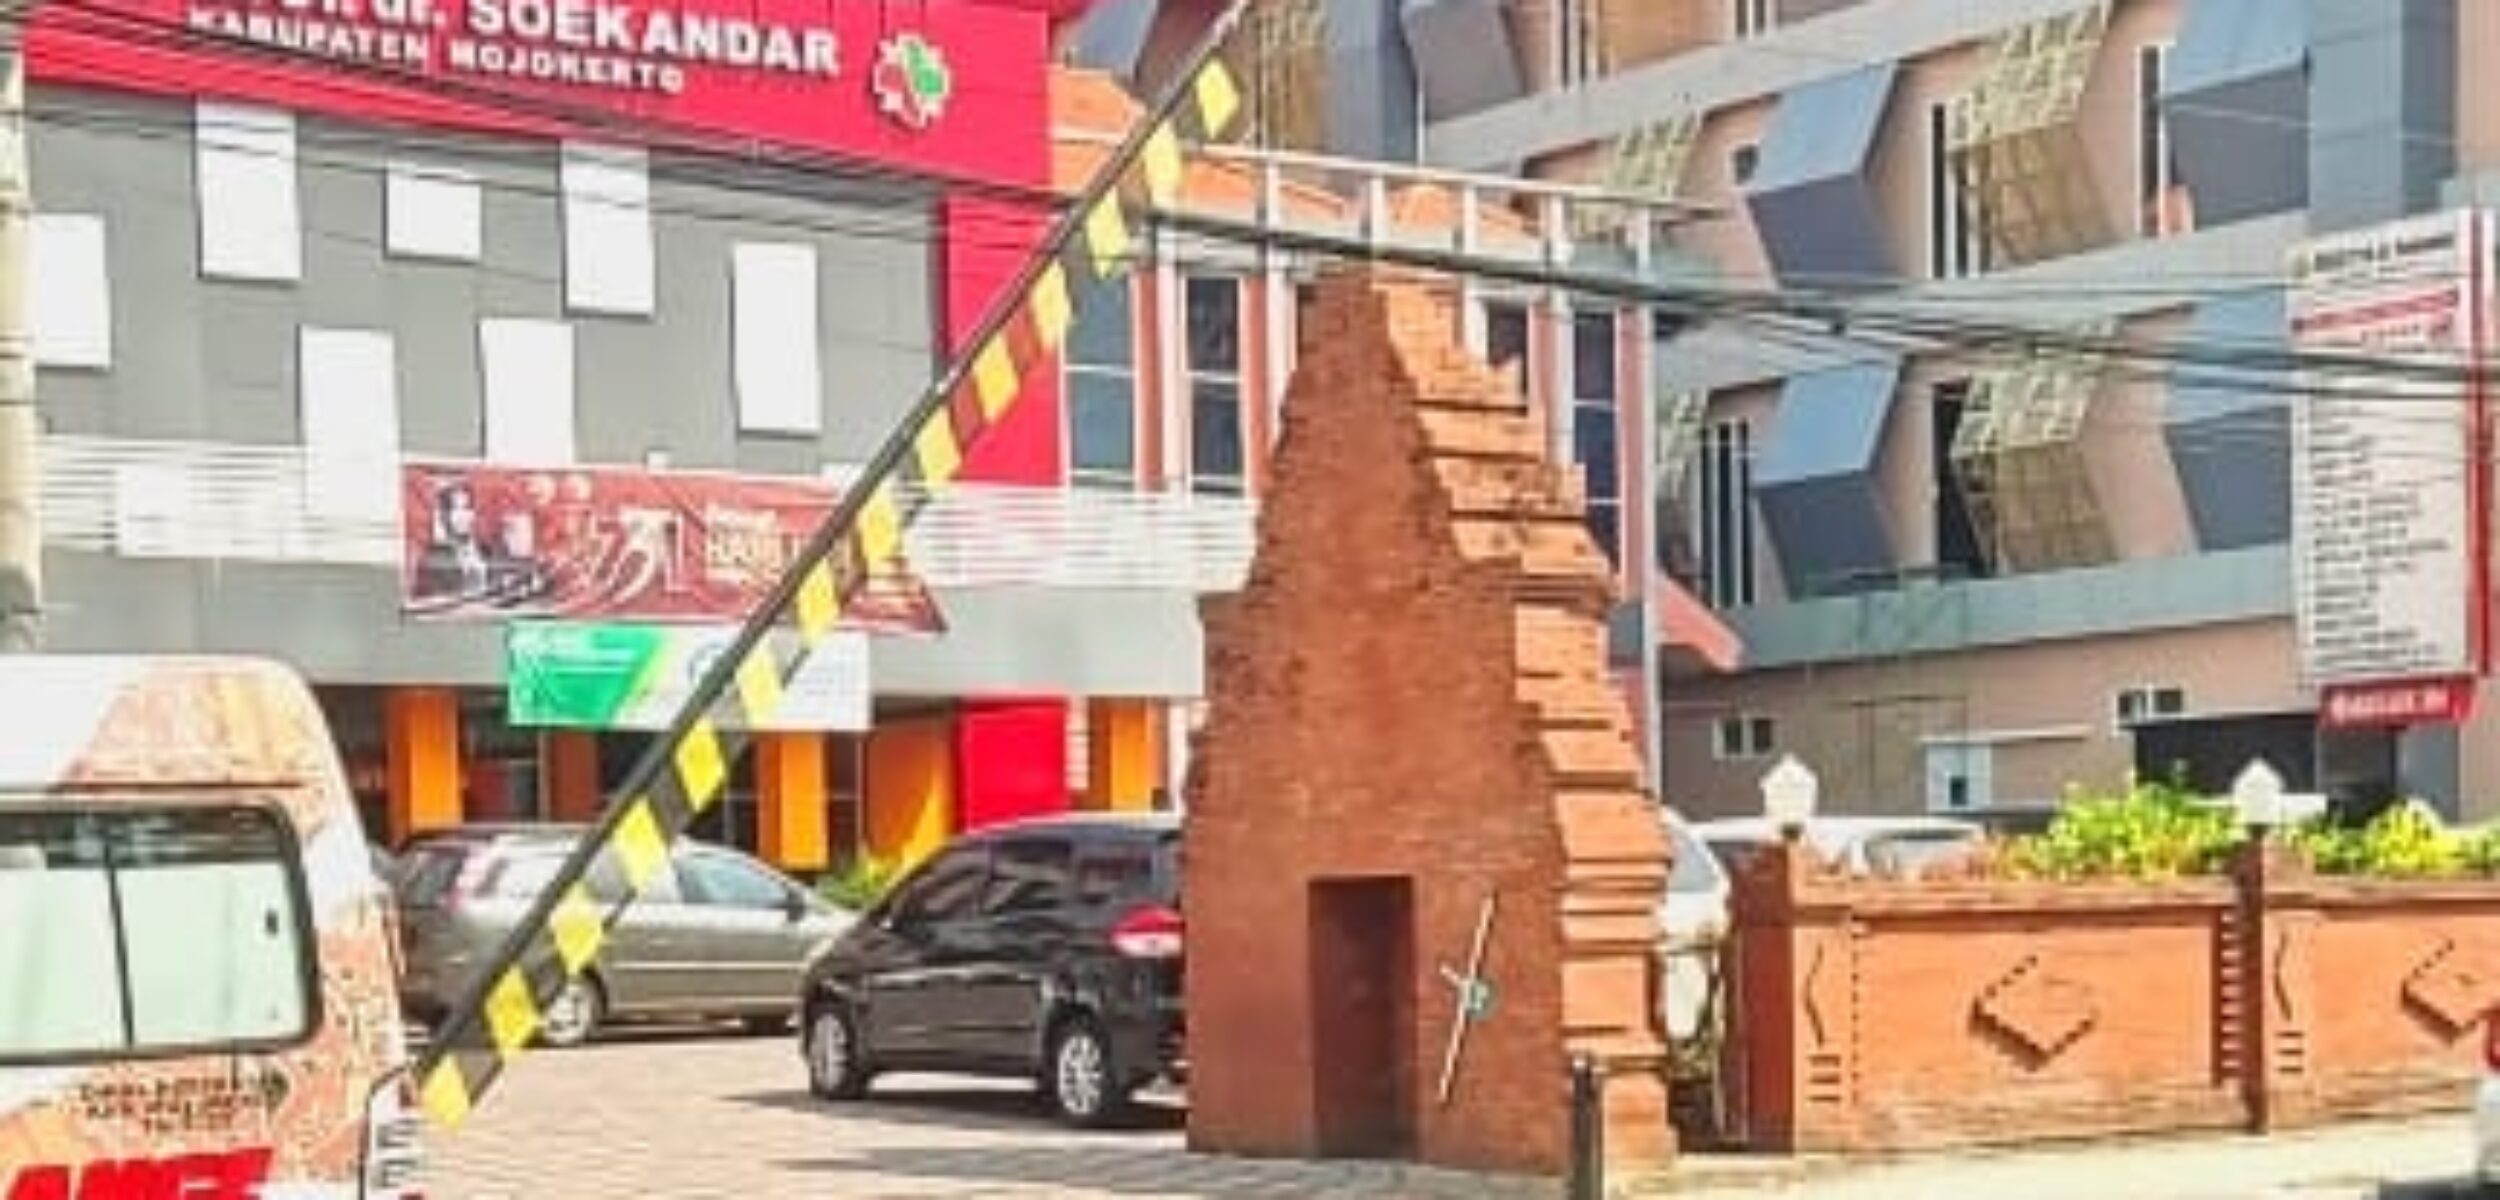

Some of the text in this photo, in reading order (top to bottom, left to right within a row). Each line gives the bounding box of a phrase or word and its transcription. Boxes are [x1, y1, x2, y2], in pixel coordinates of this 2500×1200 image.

[187, 8, 684, 93] KABUPATEN MOJOKERTO
[468, 0, 840, 76] SOEKANDAR
